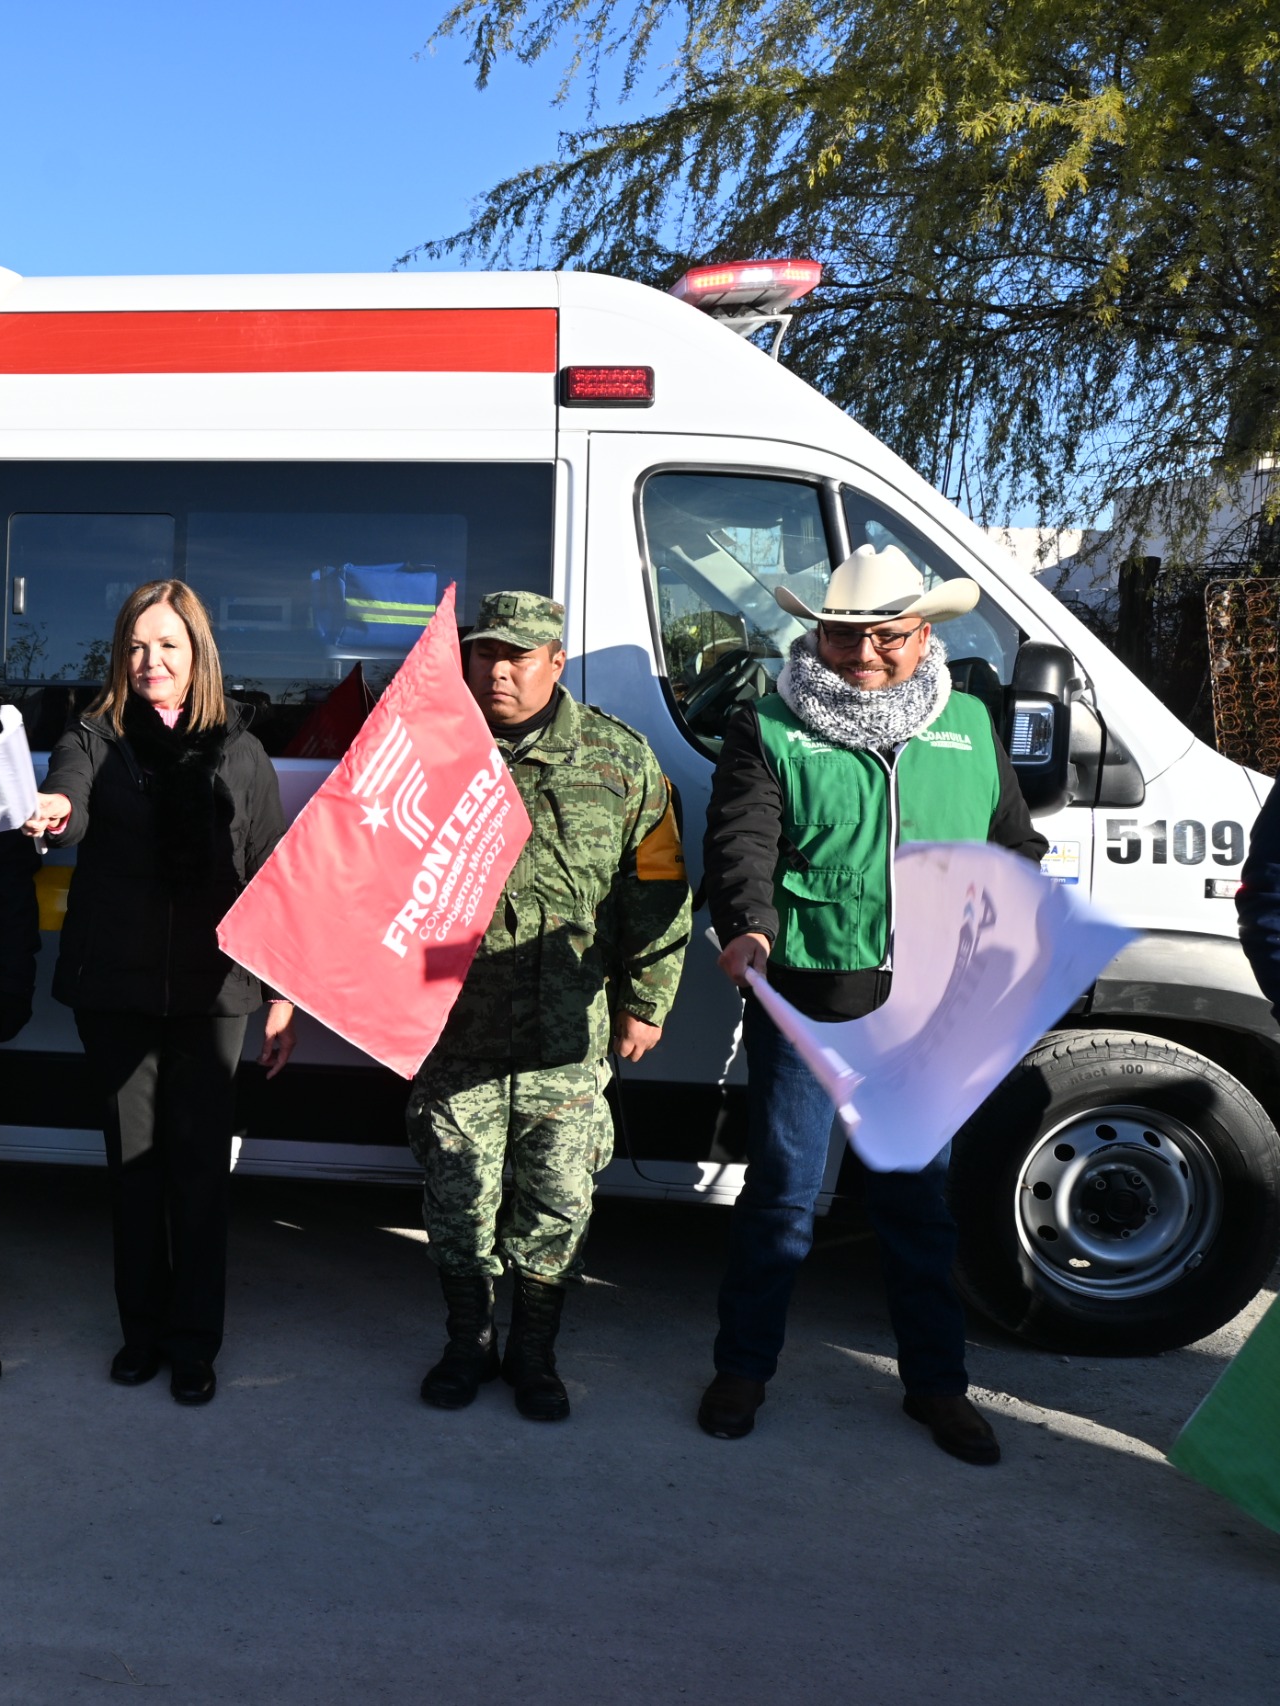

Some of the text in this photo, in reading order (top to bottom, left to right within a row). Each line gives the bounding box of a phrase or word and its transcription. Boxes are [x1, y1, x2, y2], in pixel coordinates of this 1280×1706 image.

[916, 730, 972, 746] COAHUILA
[381, 747, 504, 959] FRONTERA
[1106, 818, 1245, 866] 5109
[435, 799, 512, 942] Gobierno Municipal
[1120, 1064, 1144, 1075] 100
